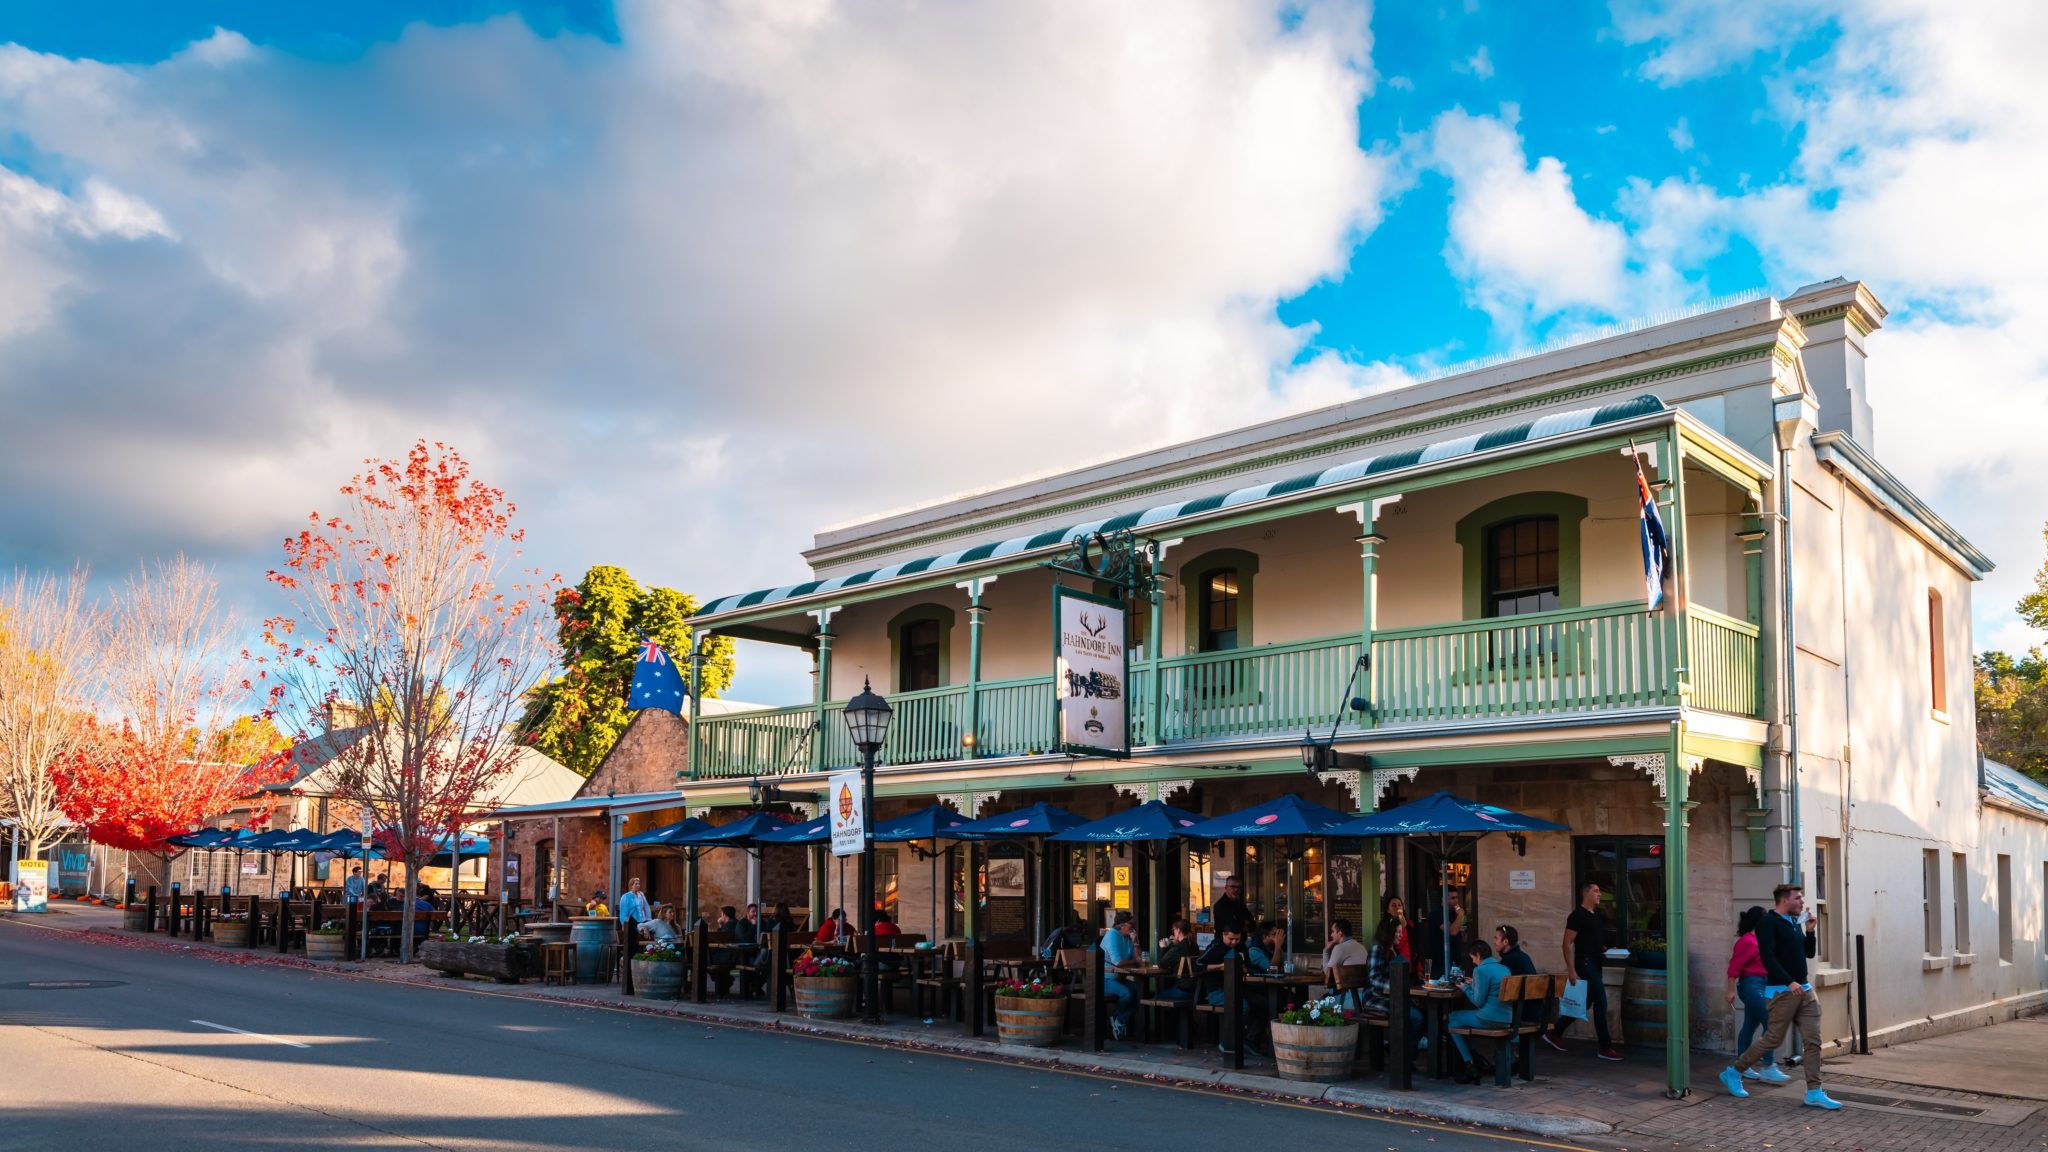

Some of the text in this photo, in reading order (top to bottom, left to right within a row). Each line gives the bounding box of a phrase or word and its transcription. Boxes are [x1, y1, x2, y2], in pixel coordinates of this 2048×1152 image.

[1063, 632, 1106, 653] HAHNDORF
[1108, 641, 1122, 656] INN
[832, 828, 862, 839] HAHNDORF
